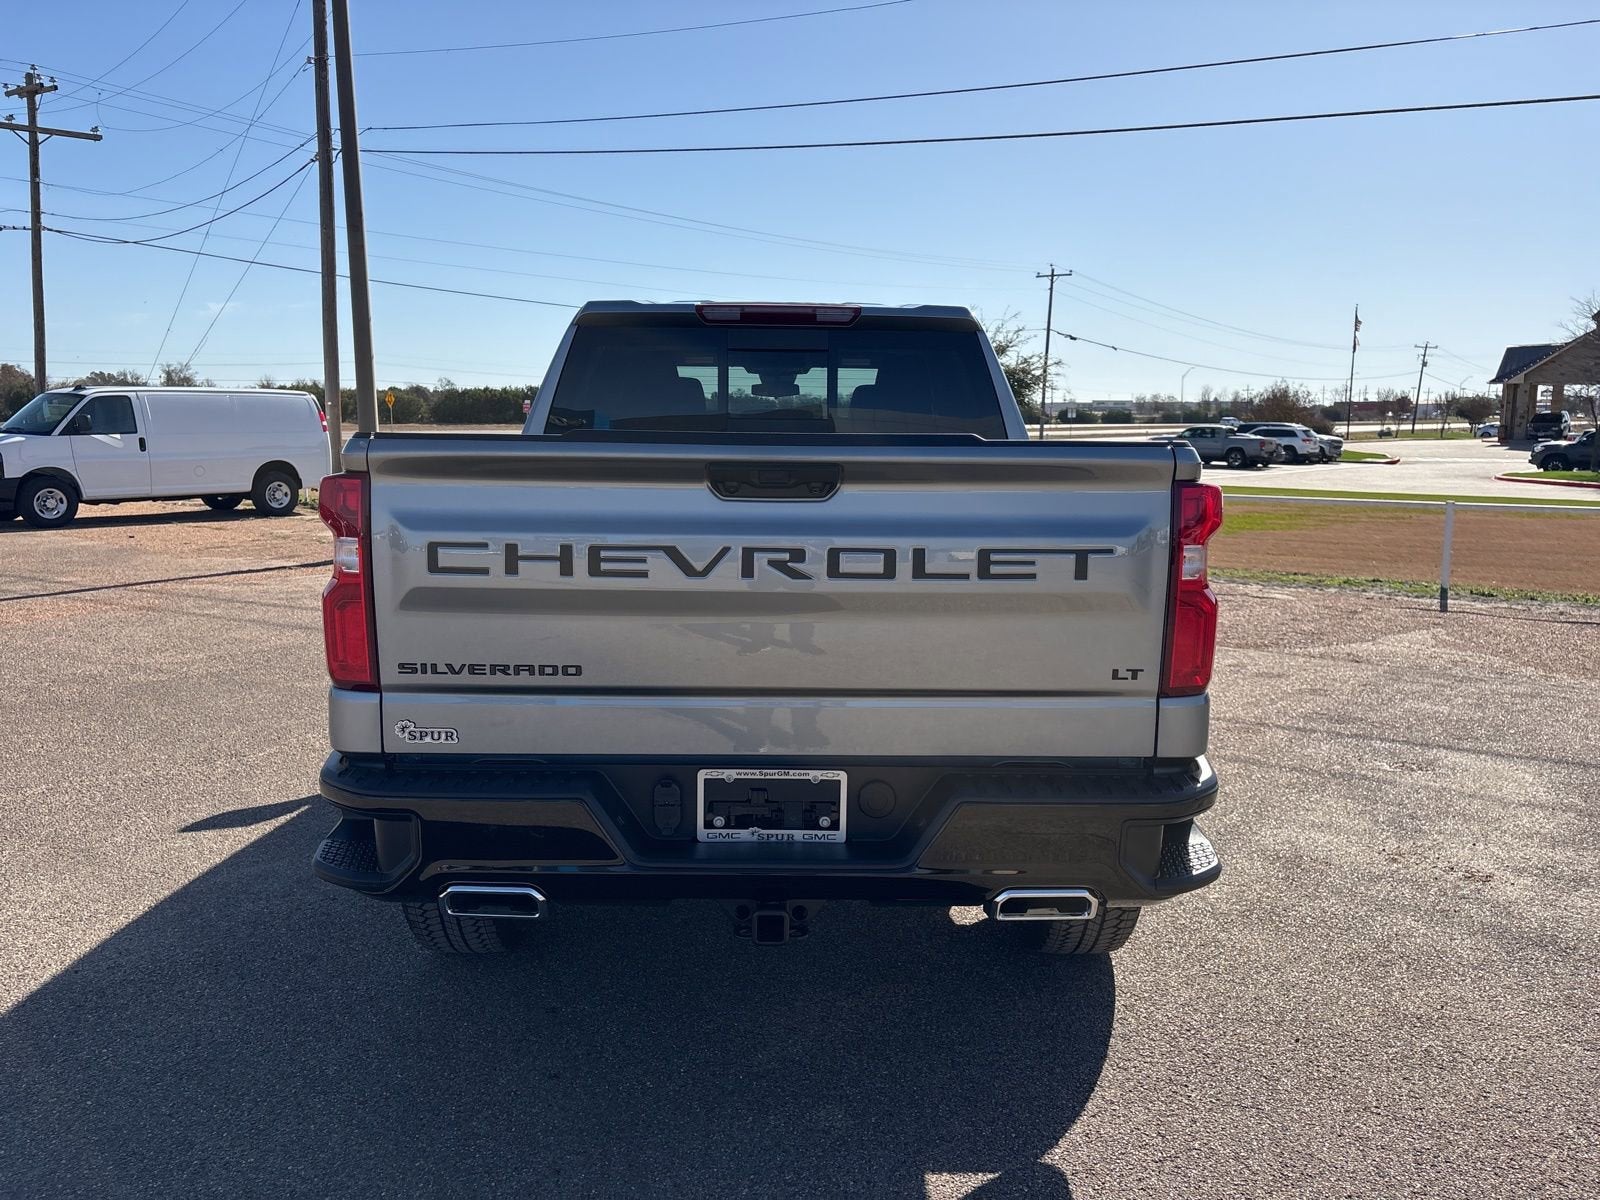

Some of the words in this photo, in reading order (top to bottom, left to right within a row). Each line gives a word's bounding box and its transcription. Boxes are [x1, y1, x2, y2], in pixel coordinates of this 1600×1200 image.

[427, 541, 1115, 580] CHEVROLET
[397, 662, 582, 677] SILVERADO
[1111, 669, 1145, 681] LT
[407, 730, 457, 742] SPUR
[735, 770, 810, 778] www.SpurGM.com
[706, 832, 742, 840] GMC
[757, 833, 795, 841] SPUR
[802, 833, 837, 841] GMC
